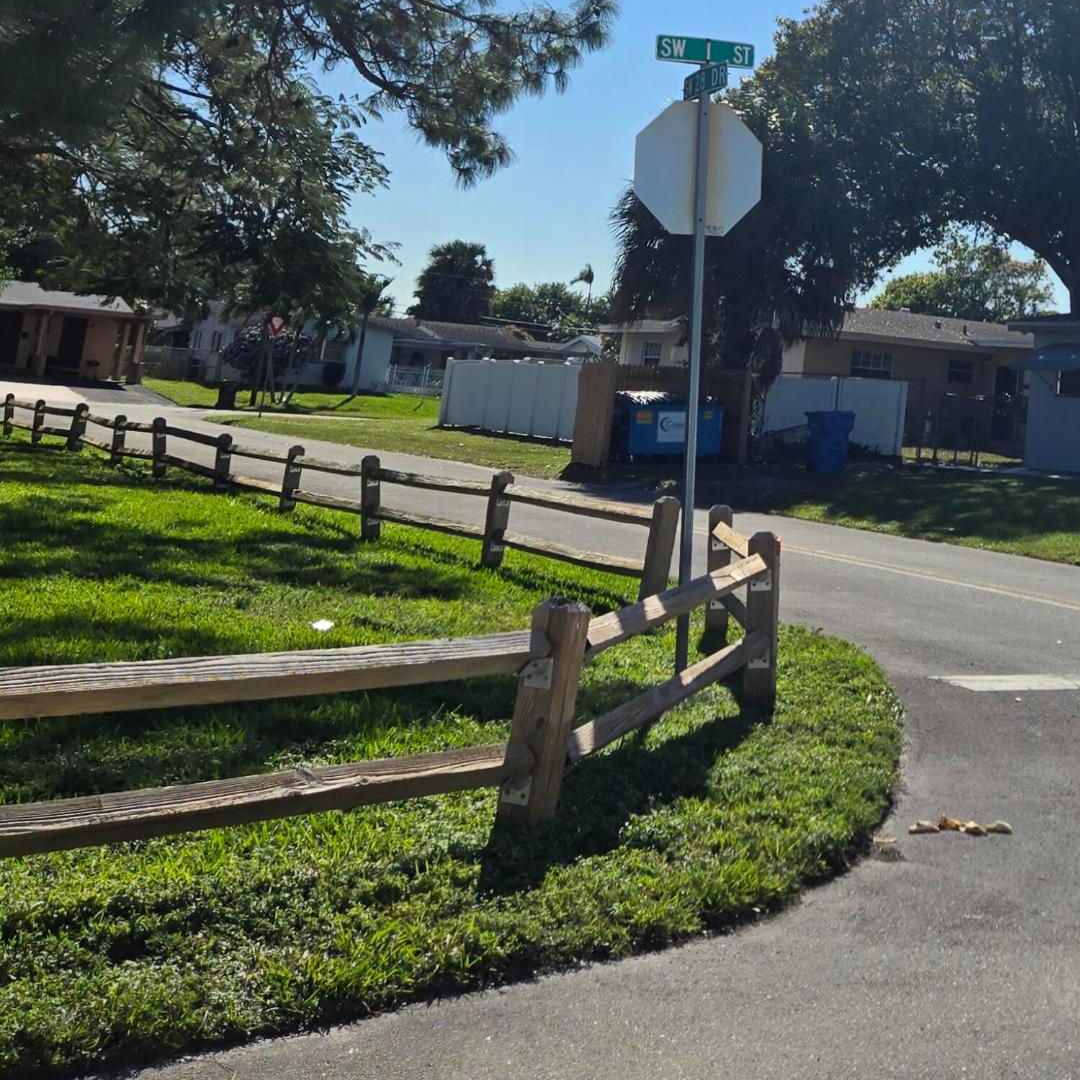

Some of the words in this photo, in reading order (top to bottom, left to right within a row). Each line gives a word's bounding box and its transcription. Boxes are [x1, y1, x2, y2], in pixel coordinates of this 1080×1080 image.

[661, 38, 687, 58] SW
[733, 45, 751, 65] ST
[711, 66, 726, 86] DR
